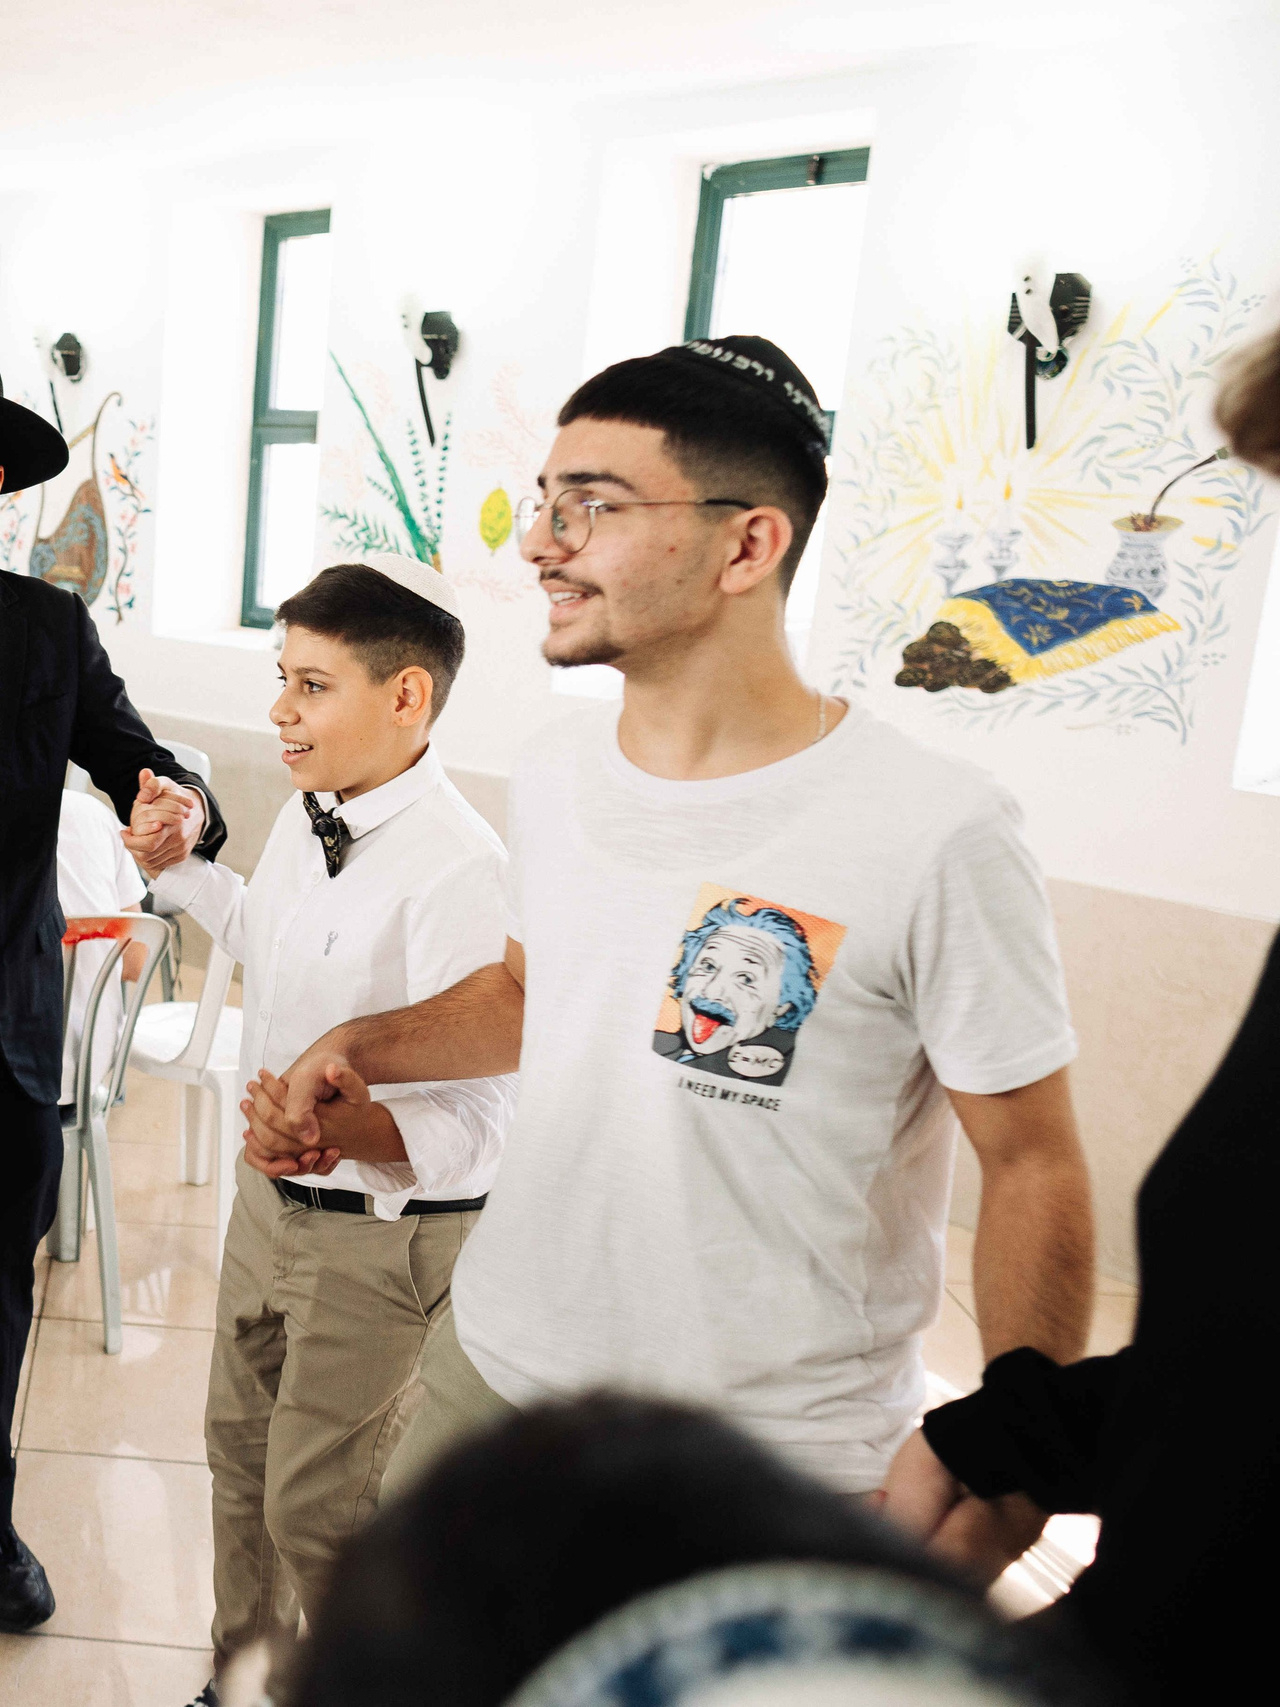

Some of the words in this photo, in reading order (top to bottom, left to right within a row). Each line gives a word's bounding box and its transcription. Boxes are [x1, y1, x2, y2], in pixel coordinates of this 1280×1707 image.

[678, 1076, 684, 1088] I
[686, 1079, 717, 1099] NEED
[719, 1088, 740, 1102] MY
[741, 1093, 782, 1112] SPACE
